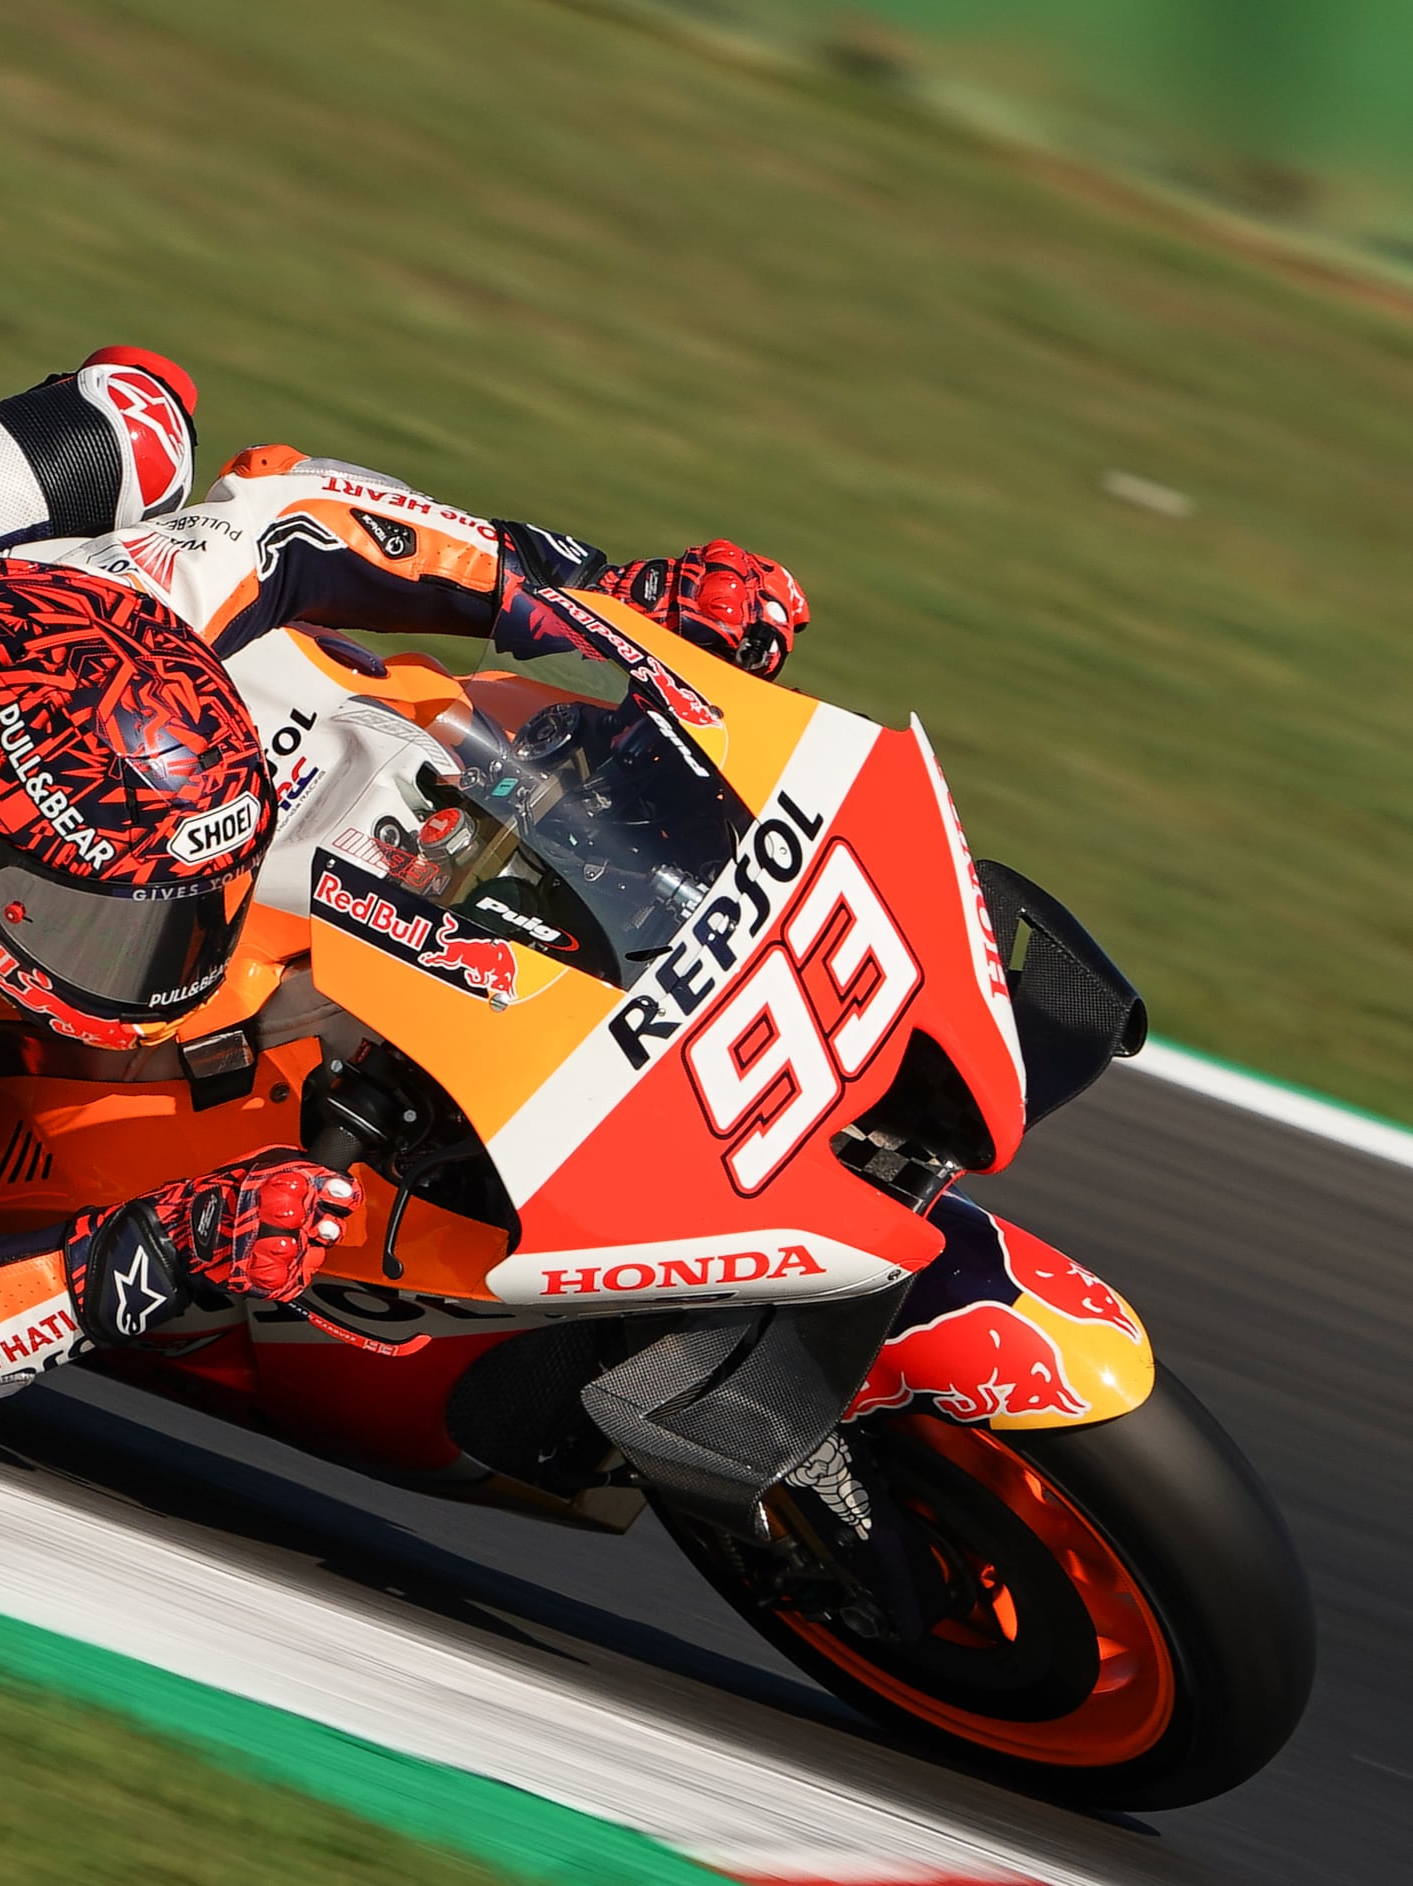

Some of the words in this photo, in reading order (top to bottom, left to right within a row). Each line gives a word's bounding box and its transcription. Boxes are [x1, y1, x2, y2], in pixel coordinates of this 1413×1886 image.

[441, 508, 503, 542] One
[188, 803, 252, 855] SHOEI
[132, 884, 199, 902] GIVES
[313, 870, 376, 925] Red
[368, 897, 434, 952] Bull
[476, 896, 563, 943] Puig
[608, 789, 824, 1071] REPSOL
[681, 835, 925, 1199] 93
[539, 1244, 827, 1297] HONDA
[0, 1309, 79, 1363] HATI
